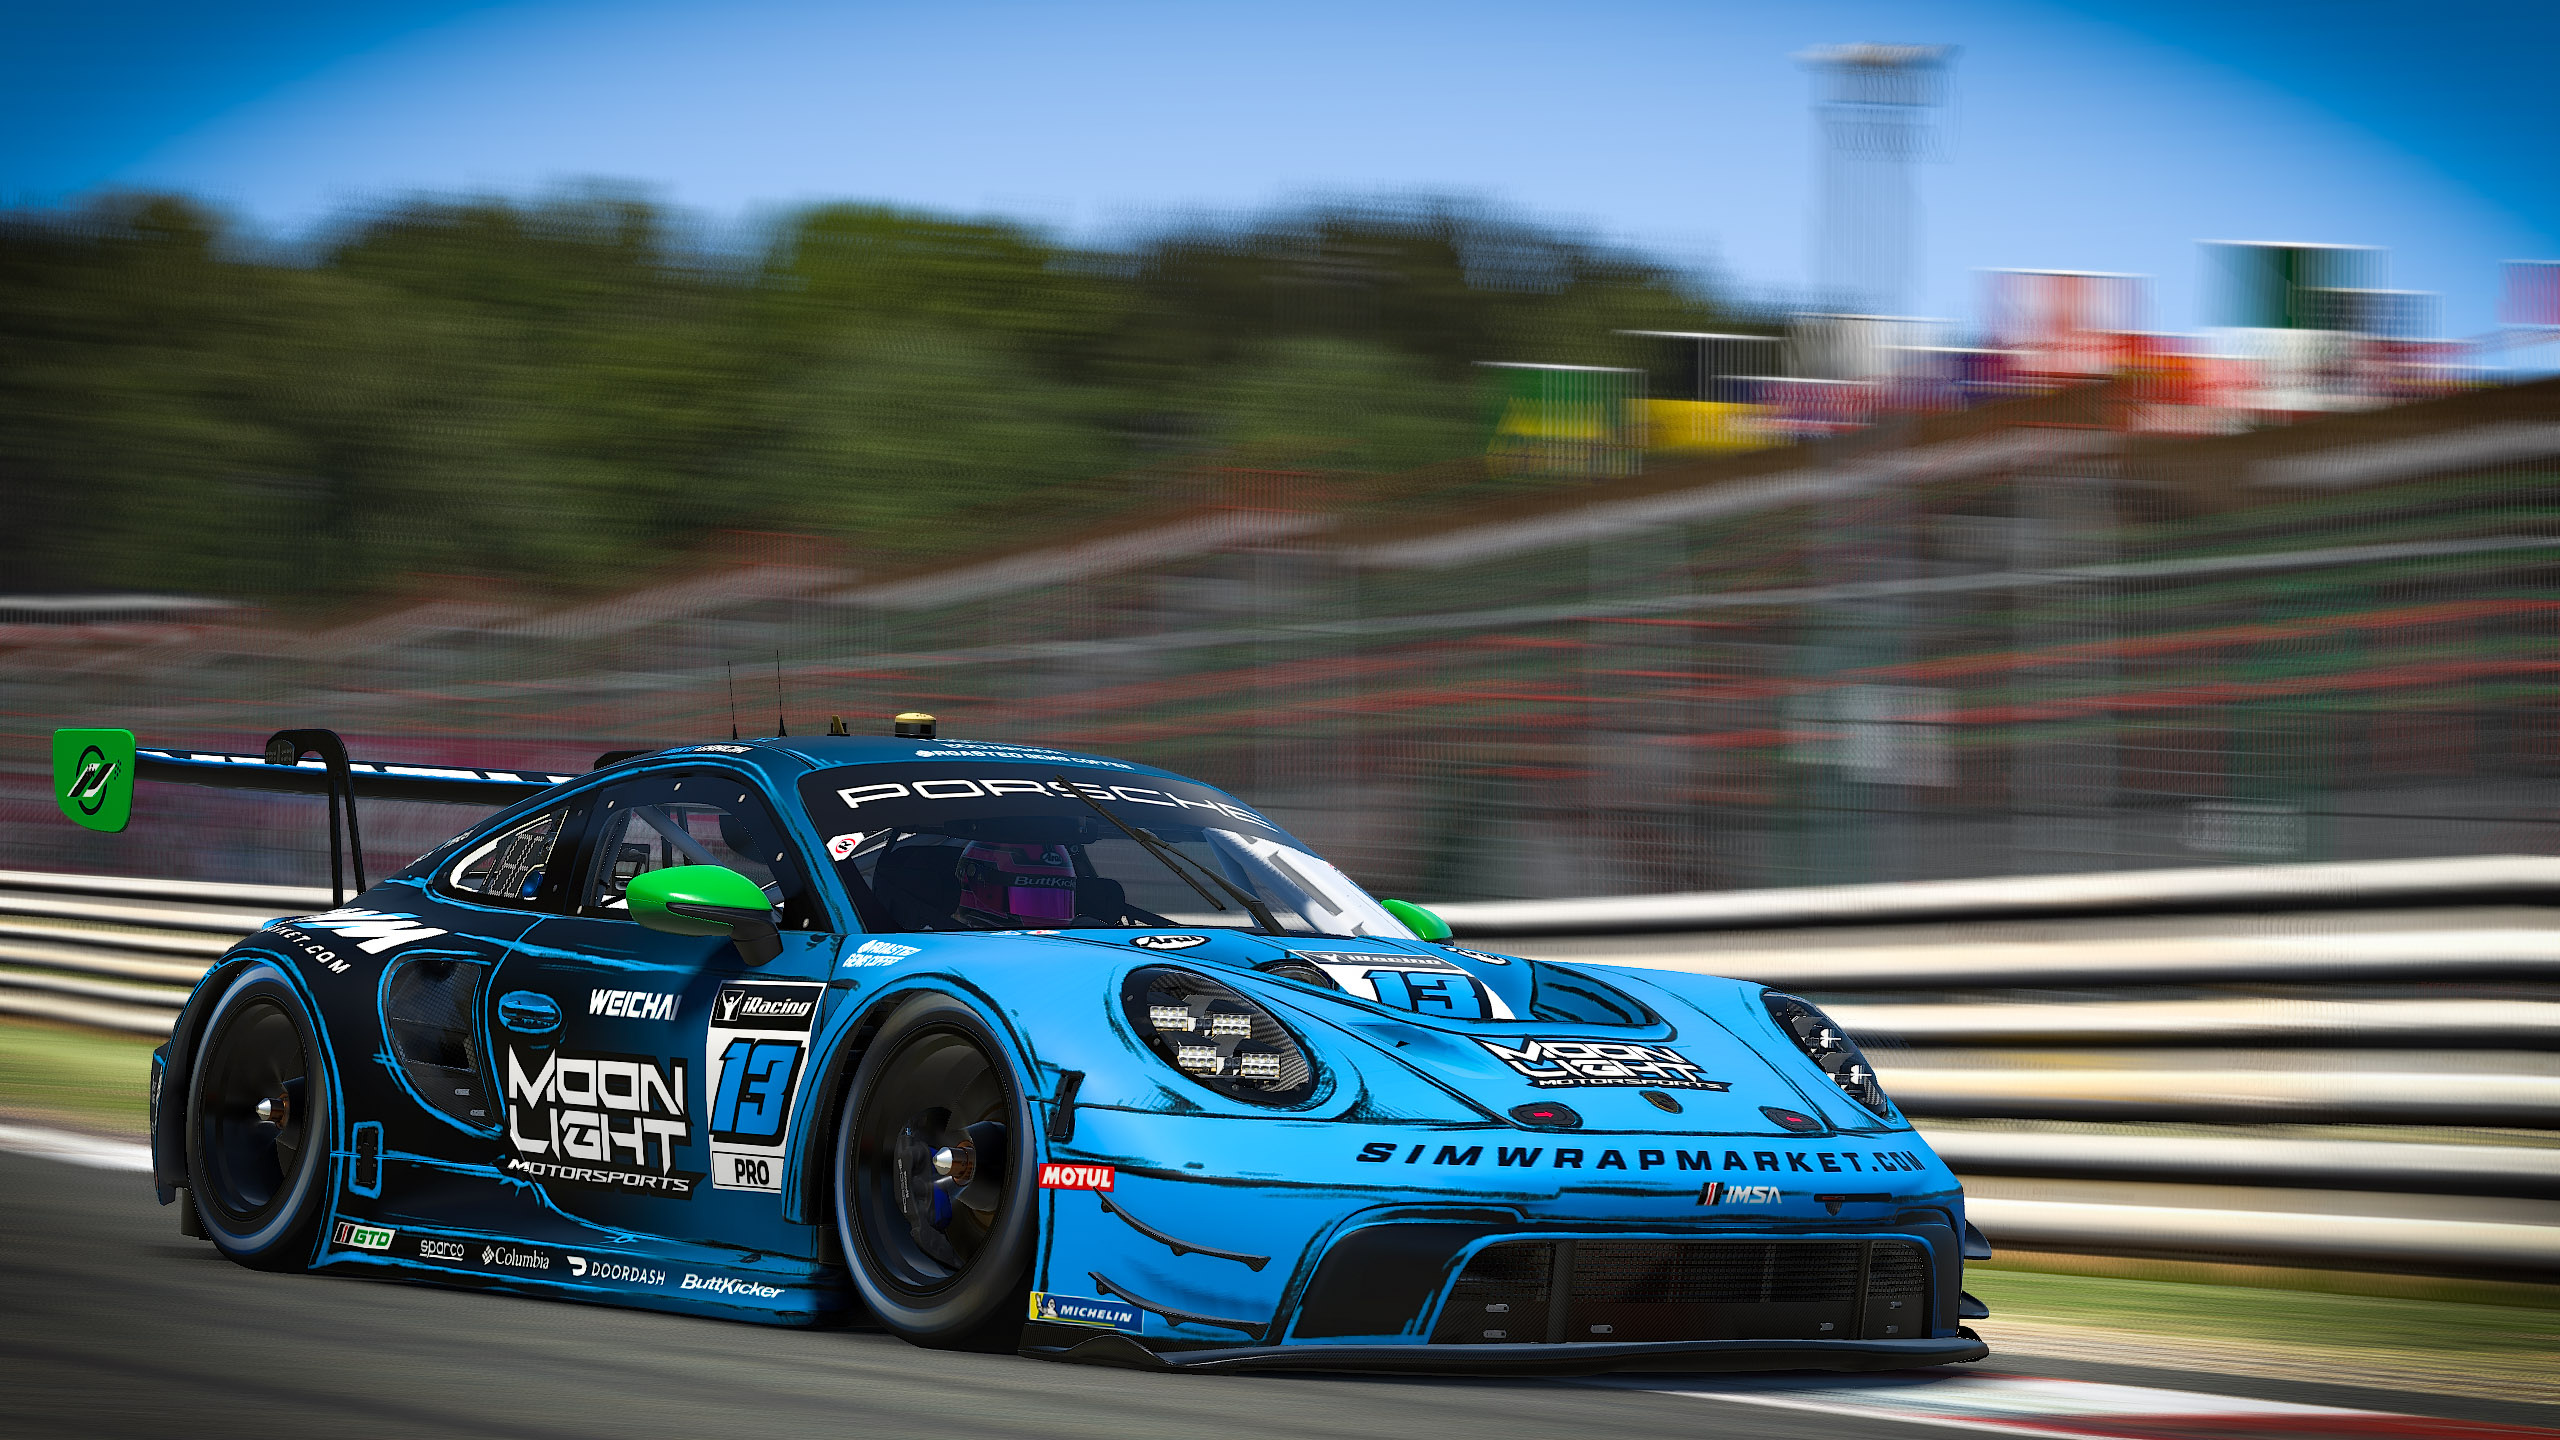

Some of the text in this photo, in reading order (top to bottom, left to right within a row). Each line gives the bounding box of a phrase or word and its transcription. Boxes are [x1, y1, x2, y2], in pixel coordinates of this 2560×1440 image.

[837, 779, 1280, 834] PORSCHE
[1347, 954, 1442, 965] iRacing
[588, 989, 682, 1021] WEICHAI
[1362, 969, 1493, 1019] 13
[741, 997, 814, 1016] iRacing
[1478, 1040, 1688, 1062] MOON
[508, 1044, 685, 1116] MOON
[1506, 1059, 1702, 1083] LIGHT
[709, 1037, 806, 1147] 13
[1538, 1078, 1723, 1089] MOTORSPORTS
[508, 1104, 687, 1177] LIGHT
[1355, 1142, 1927, 1173] SIMWRAPMARKET.COM
[508, 1158, 690, 1192] MOTORSPORTS
[734, 1158, 770, 1185] PRO
[1041, 1166, 1111, 1188] MOTUL
[1726, 1185, 1783, 1204] IMSA
[353, 1229, 390, 1247] GTD
[420, 1239, 465, 1258] sparco
[495, 1247, 549, 1269] Columbia
[591, 1261, 667, 1286] DOORDASH
[679, 1273, 785, 1299] ButtKicker
[1060, 1304, 1132, 1323] MICHELIN
